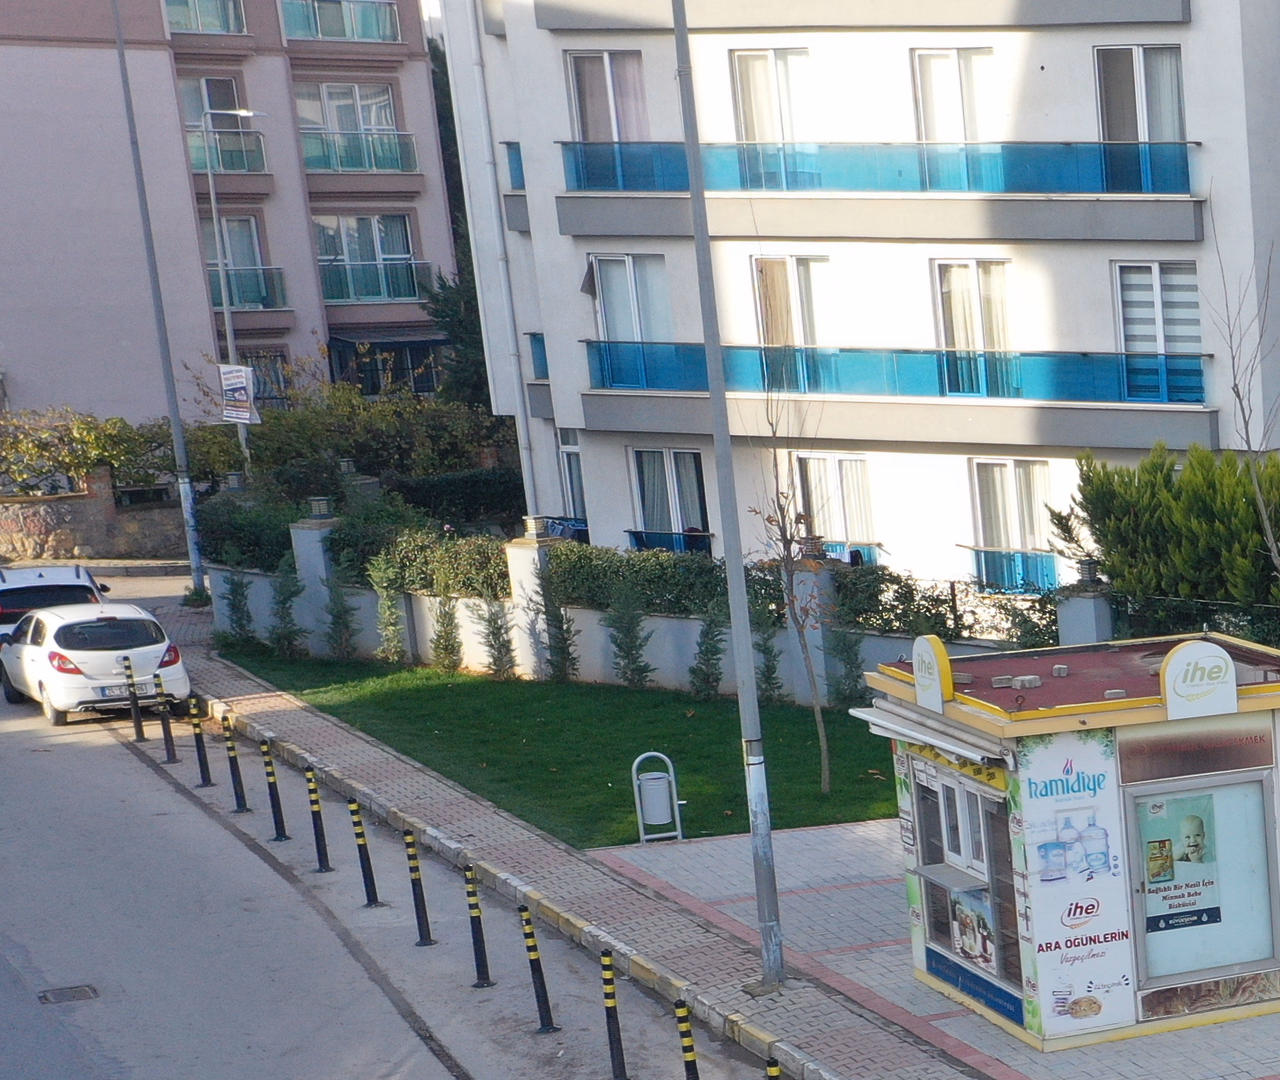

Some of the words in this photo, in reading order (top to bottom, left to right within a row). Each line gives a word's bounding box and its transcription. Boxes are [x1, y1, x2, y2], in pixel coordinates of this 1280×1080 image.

[917, 651, 934, 677] ihe
[1182, 661, 1223, 684] ihe
[1028, 771, 1106, 798] hamidiye
[1067, 902, 1096, 917] ihe
[1037, 941, 1062, 953] ARA
[1065, 929, 1129, 949] ÖĞÜNLERİN
